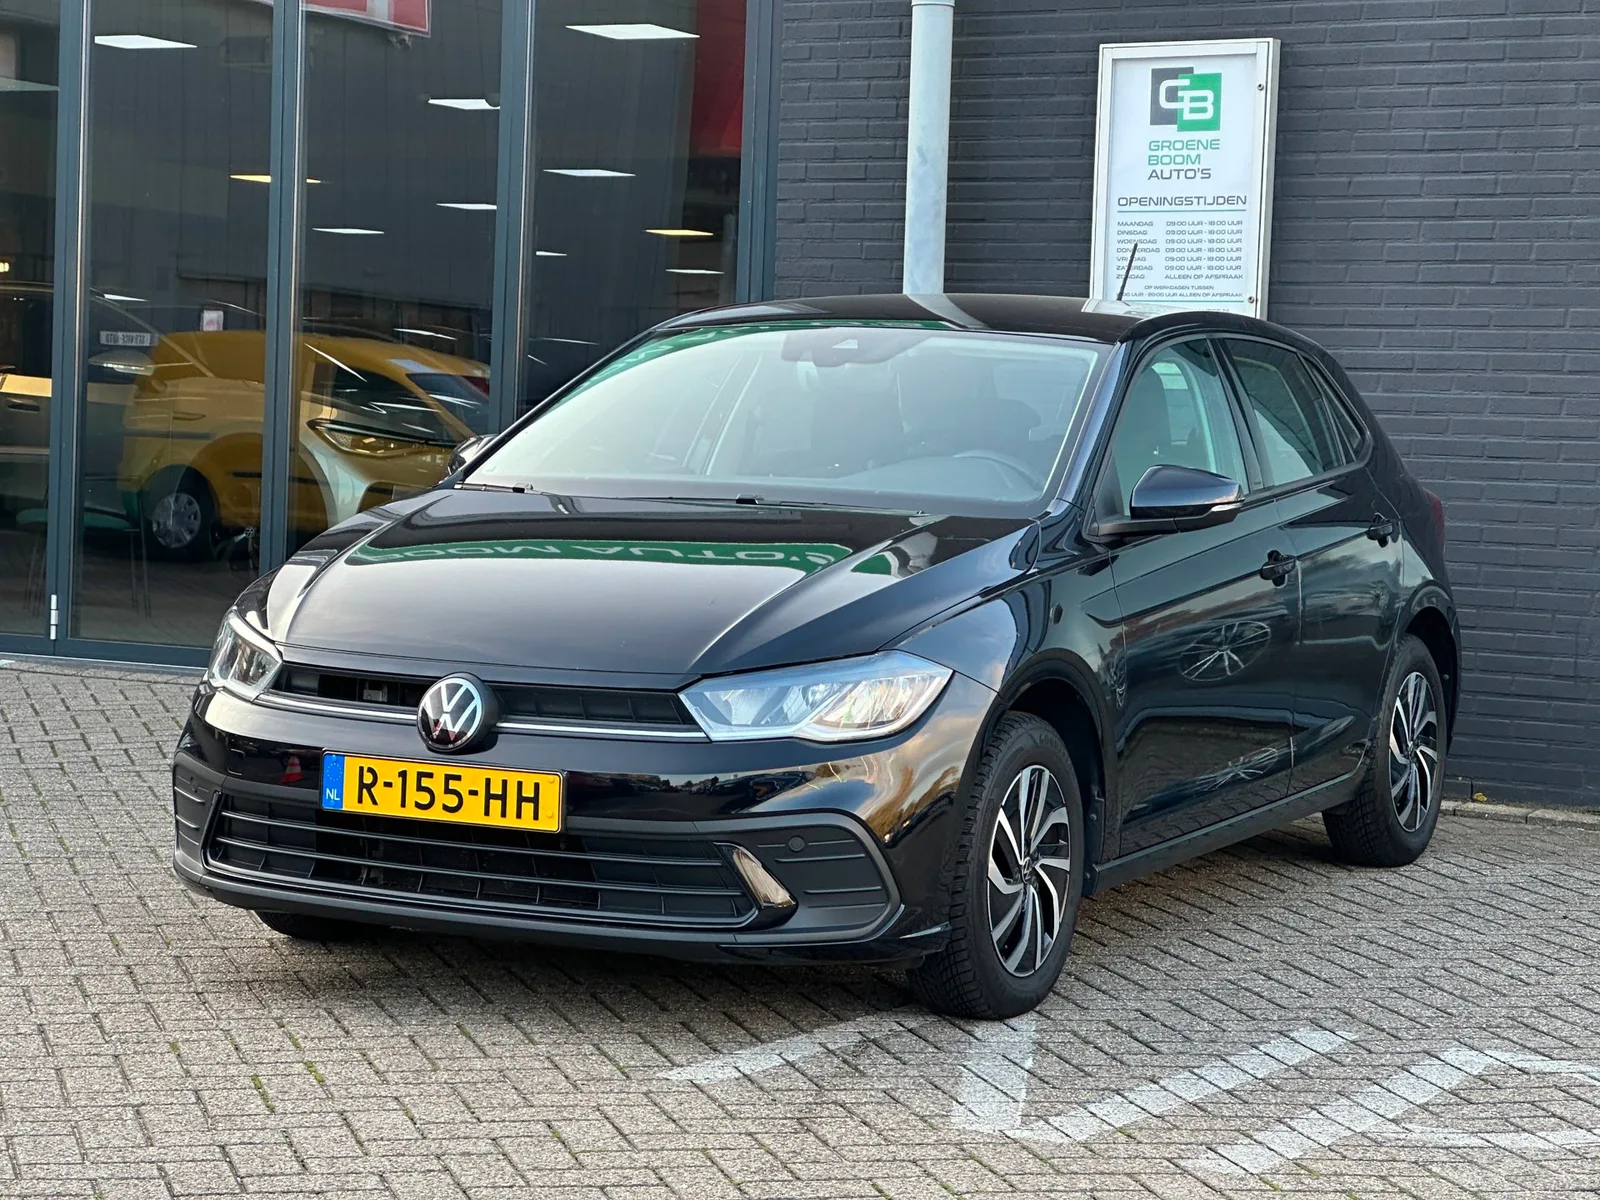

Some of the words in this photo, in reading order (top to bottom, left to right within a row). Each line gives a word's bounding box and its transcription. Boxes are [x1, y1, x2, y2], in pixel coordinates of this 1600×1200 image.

[1148, 139, 1220, 151] GROENE
[1148, 154, 1200, 166] BOOM
[1148, 168, 1212, 180] AUTO'S
[1118, 195, 1247, 206] OPENINGSTIJDEN
[326, 789, 340, 801] NL
[357, 766, 540, 821] R-155-HH
